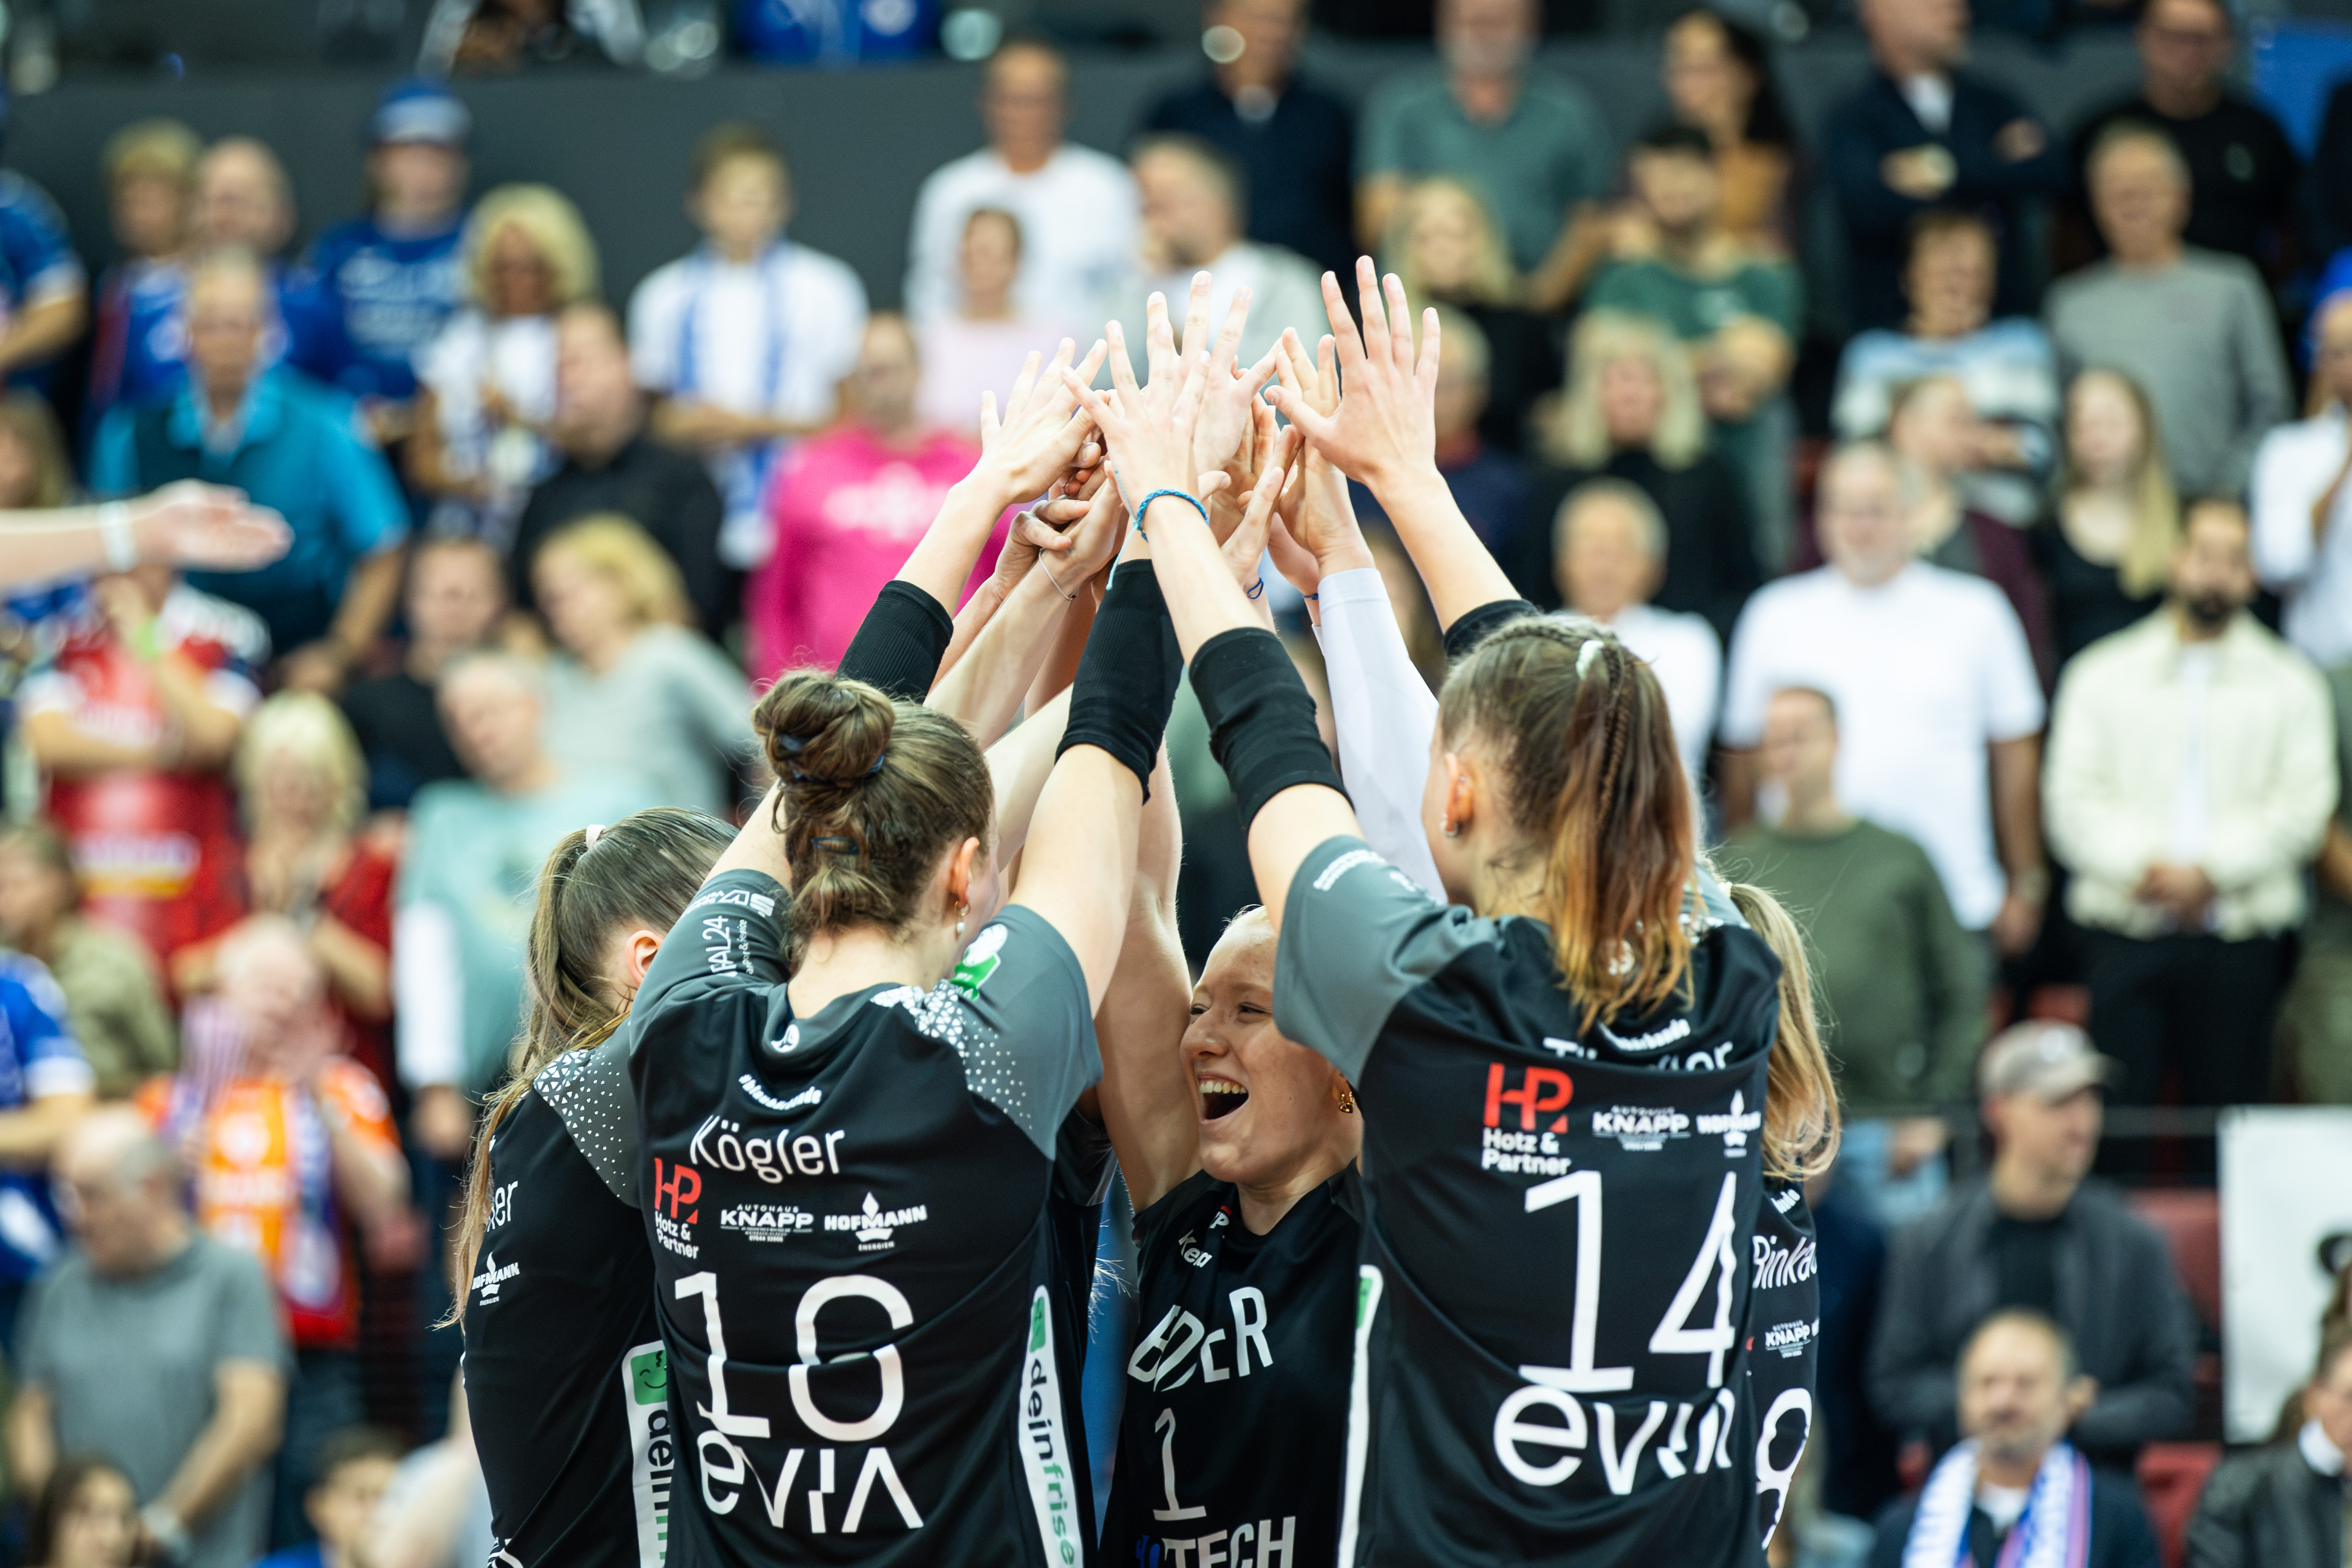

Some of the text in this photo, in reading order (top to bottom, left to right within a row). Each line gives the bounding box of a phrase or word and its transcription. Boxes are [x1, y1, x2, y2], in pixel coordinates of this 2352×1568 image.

[1483, 1062, 1574, 1132] HP
[1593, 1111, 1690, 1135] KNAPP
[690, 1114, 846, 1184] Kögler
[1483, 1127, 1560, 1155] Hotz &
[1481, 1147, 1572, 1176] Partner
[654, 1157, 702, 1219] HP
[655, 1210, 691, 1241] Hotz &
[720, 1209, 814, 1228] KNAPP
[824, 1204, 927, 1231] HOFMANN
[657, 1229, 700, 1259] Partner
[1519, 1170, 1737, 1393] 14
[1765, 1324, 1810, 1347] KNAPP
